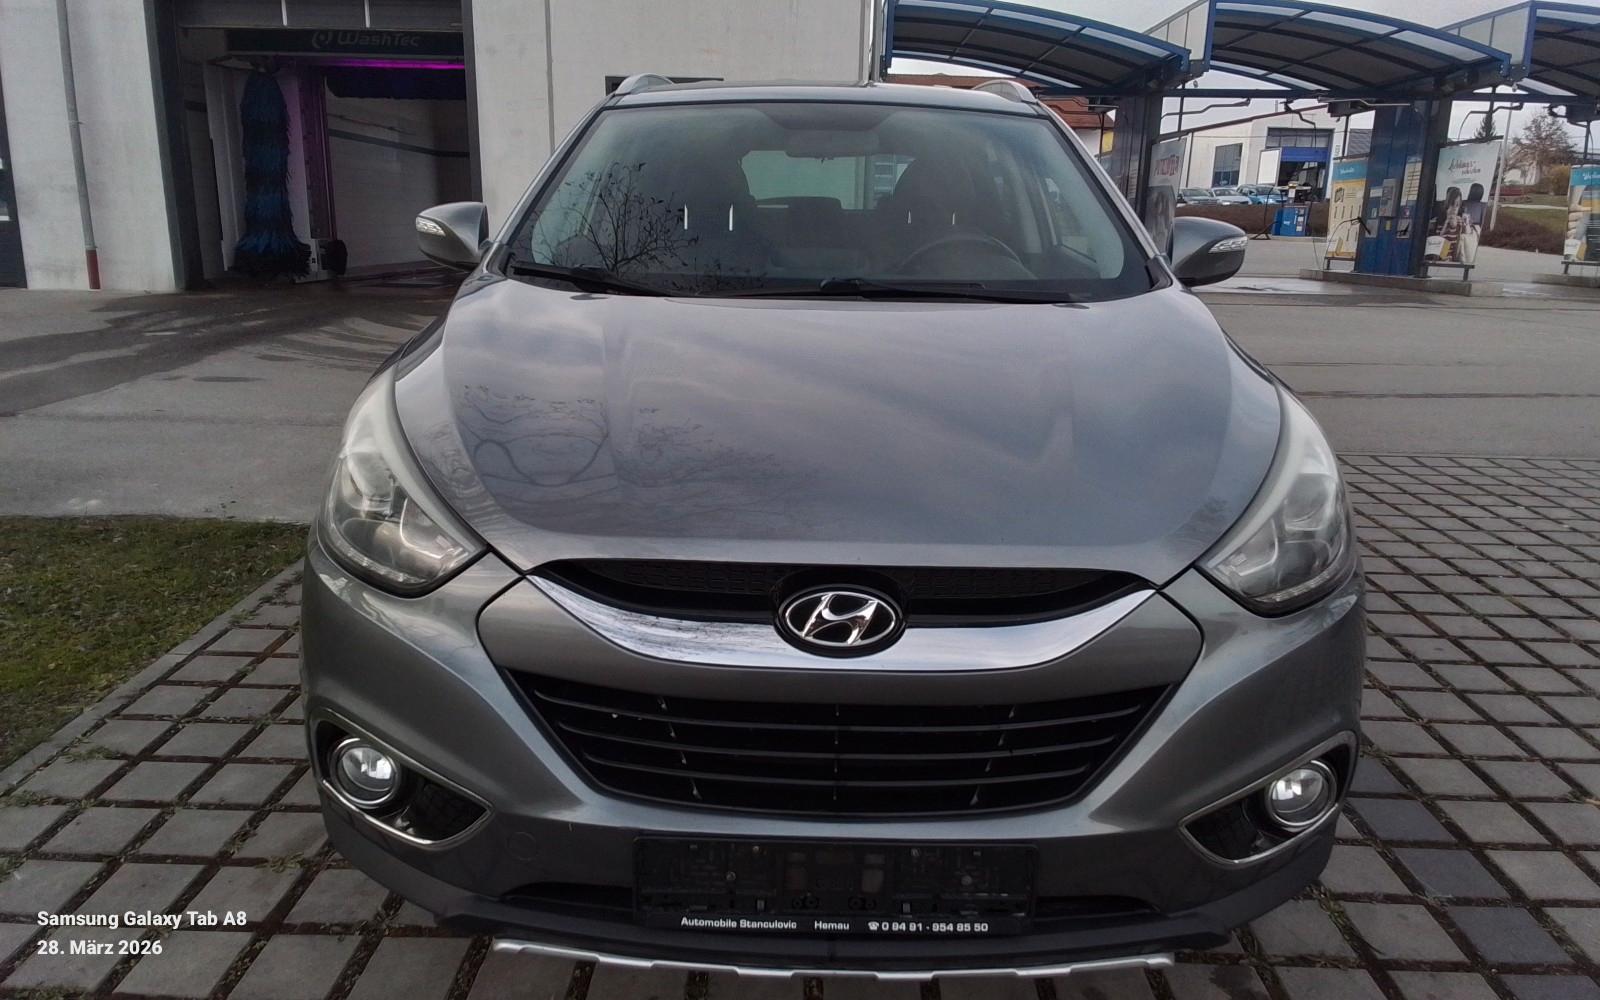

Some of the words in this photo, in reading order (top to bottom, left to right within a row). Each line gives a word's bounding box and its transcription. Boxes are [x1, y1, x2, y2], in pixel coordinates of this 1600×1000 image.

[337, 31, 421, 47] WashTec
[680, 916, 738, 928] Automobile
[739, 919, 797, 930] Stanculovic
[814, 920, 850, 931] Hemau
[881, 921, 890, 931] 0
[891, 921, 907, 932] 94
[932, 922, 954, 932] 954
[973, 922, 989, 932] 50
